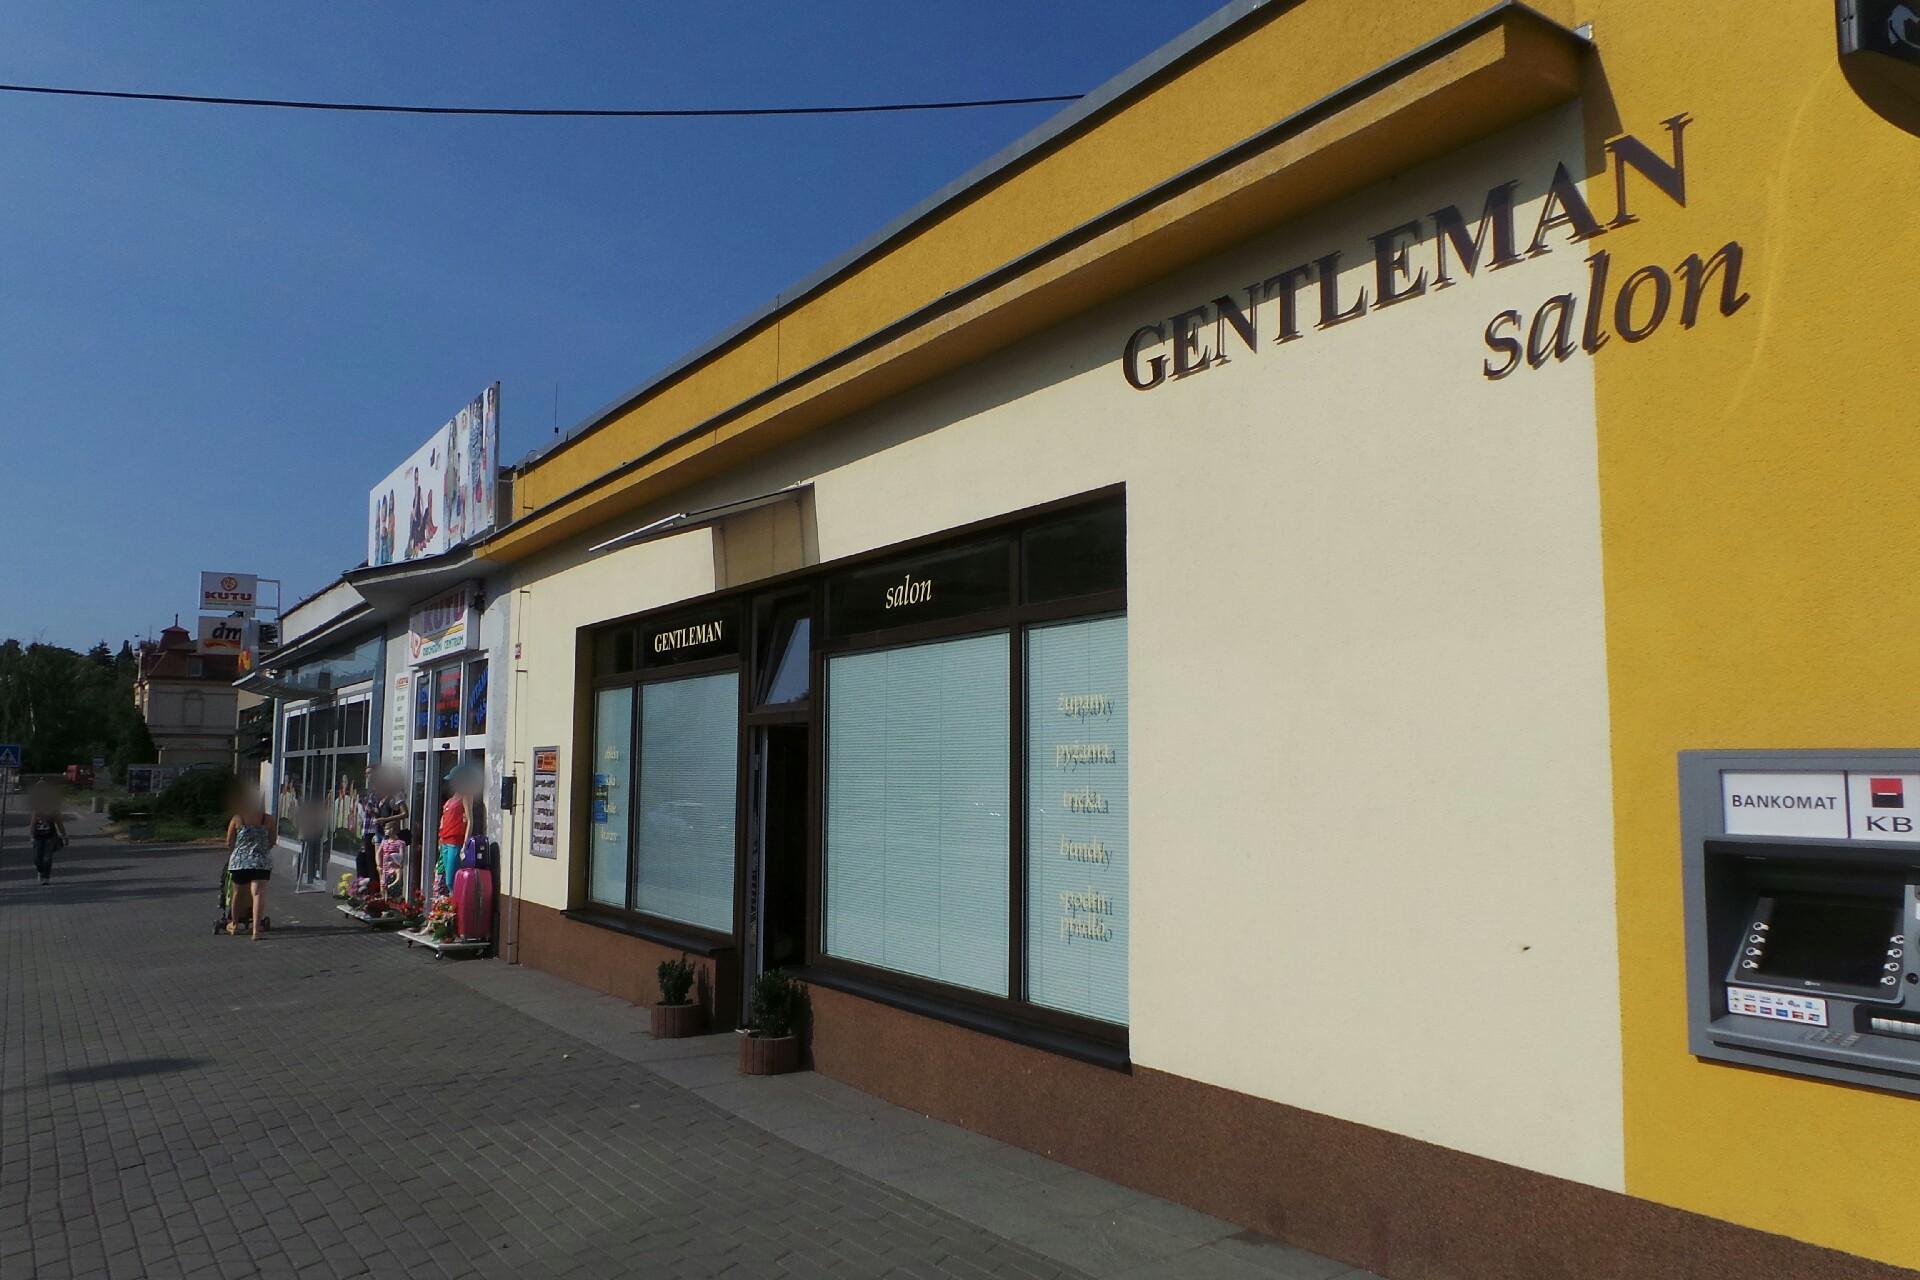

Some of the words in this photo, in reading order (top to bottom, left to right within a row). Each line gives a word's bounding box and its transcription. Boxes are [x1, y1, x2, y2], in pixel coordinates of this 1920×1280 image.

[1121, 111, 1693, 391] GENTLEMAN
[1483, 240, 1751, 381] salon
[204, 591, 252, 601] KUTU
[884, 573, 933, 609] salon
[654, 620, 723, 653] GENTLEMAN
[1732, 794, 1837, 810] BANKOMAT
[1866, 815, 1913, 833] KB
